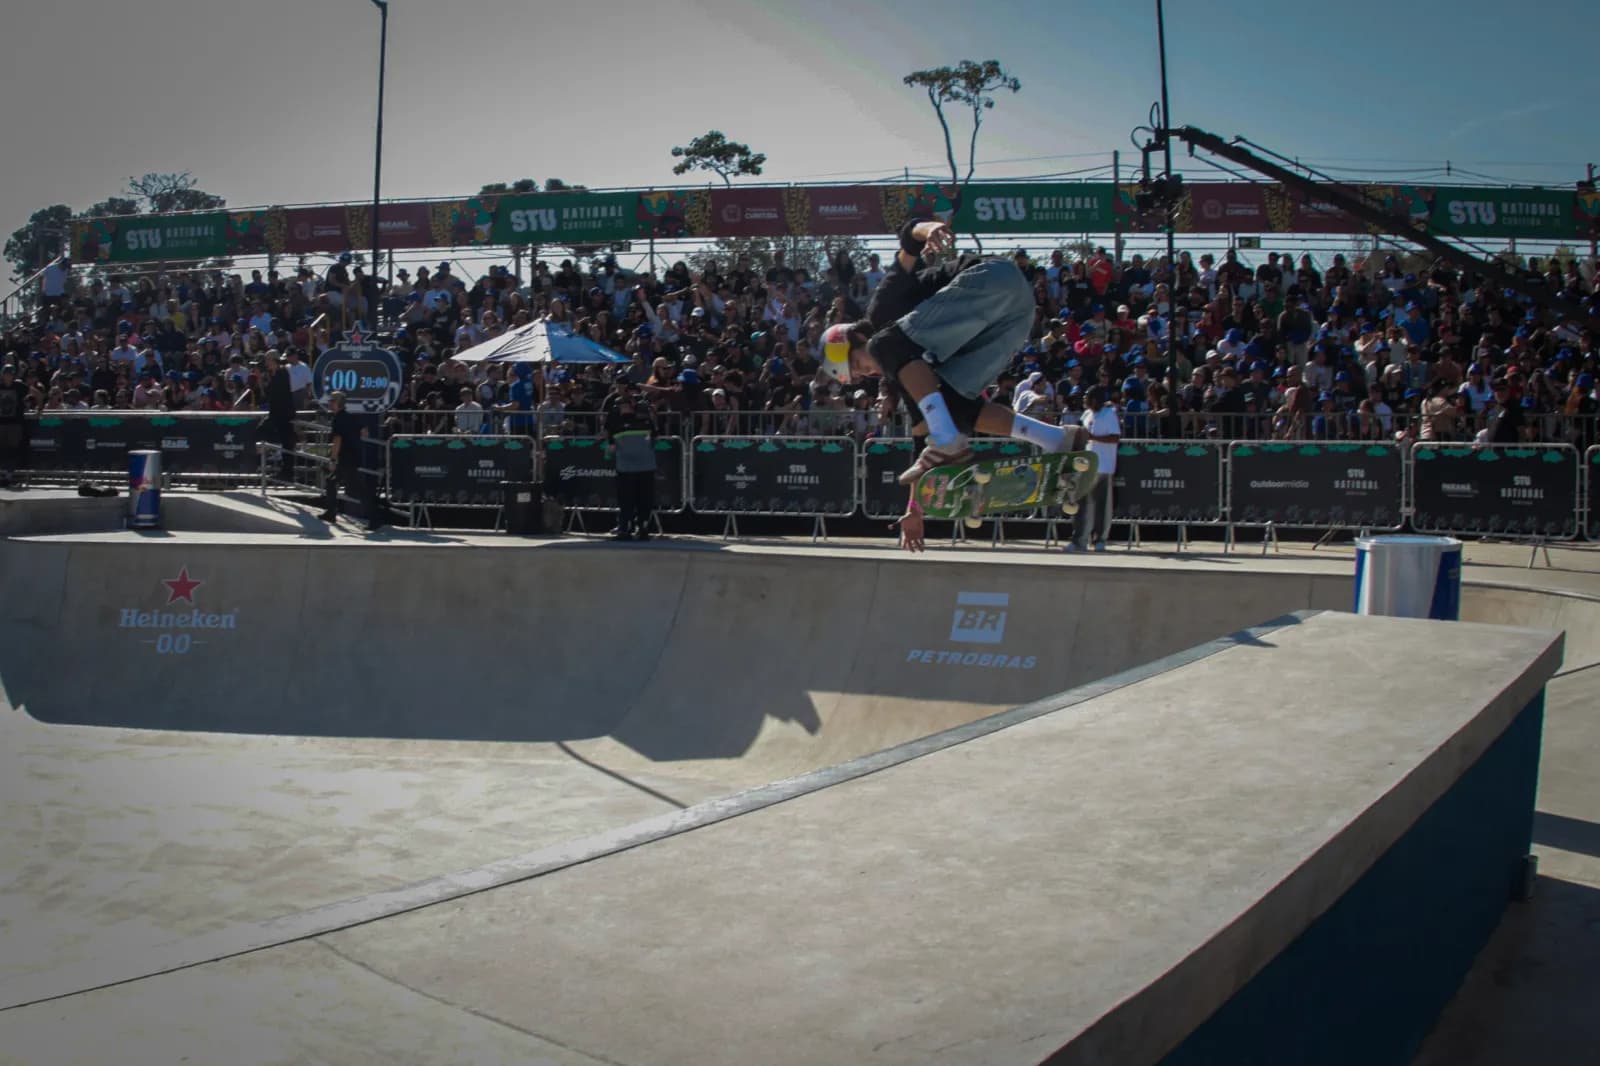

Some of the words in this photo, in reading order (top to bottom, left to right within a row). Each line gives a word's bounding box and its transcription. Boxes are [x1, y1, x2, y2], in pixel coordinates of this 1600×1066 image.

[510, 208, 558, 232] STU
[562, 205, 625, 220] NATIONAL
[974, 197, 1027, 221] STU
[1032, 197, 1099, 209] NATIONAL
[1447, 200, 1497, 225] STU
[1501, 202, 1561, 216] NATIONAL
[125, 228, 162, 250] STU
[166, 225, 215, 238] NATIONAL
[776, 475, 820, 485] NATIONAL
[1140, 480, 1185, 489] NATIONAL
[1333, 480, 1379, 490] NATIONAL
[1500, 487, 1545, 499] NATIONAL
[118, 608, 238, 629] Heineken
[957, 608, 999, 632] BR
[905, 648, 1039, 670] PETROBRAS
